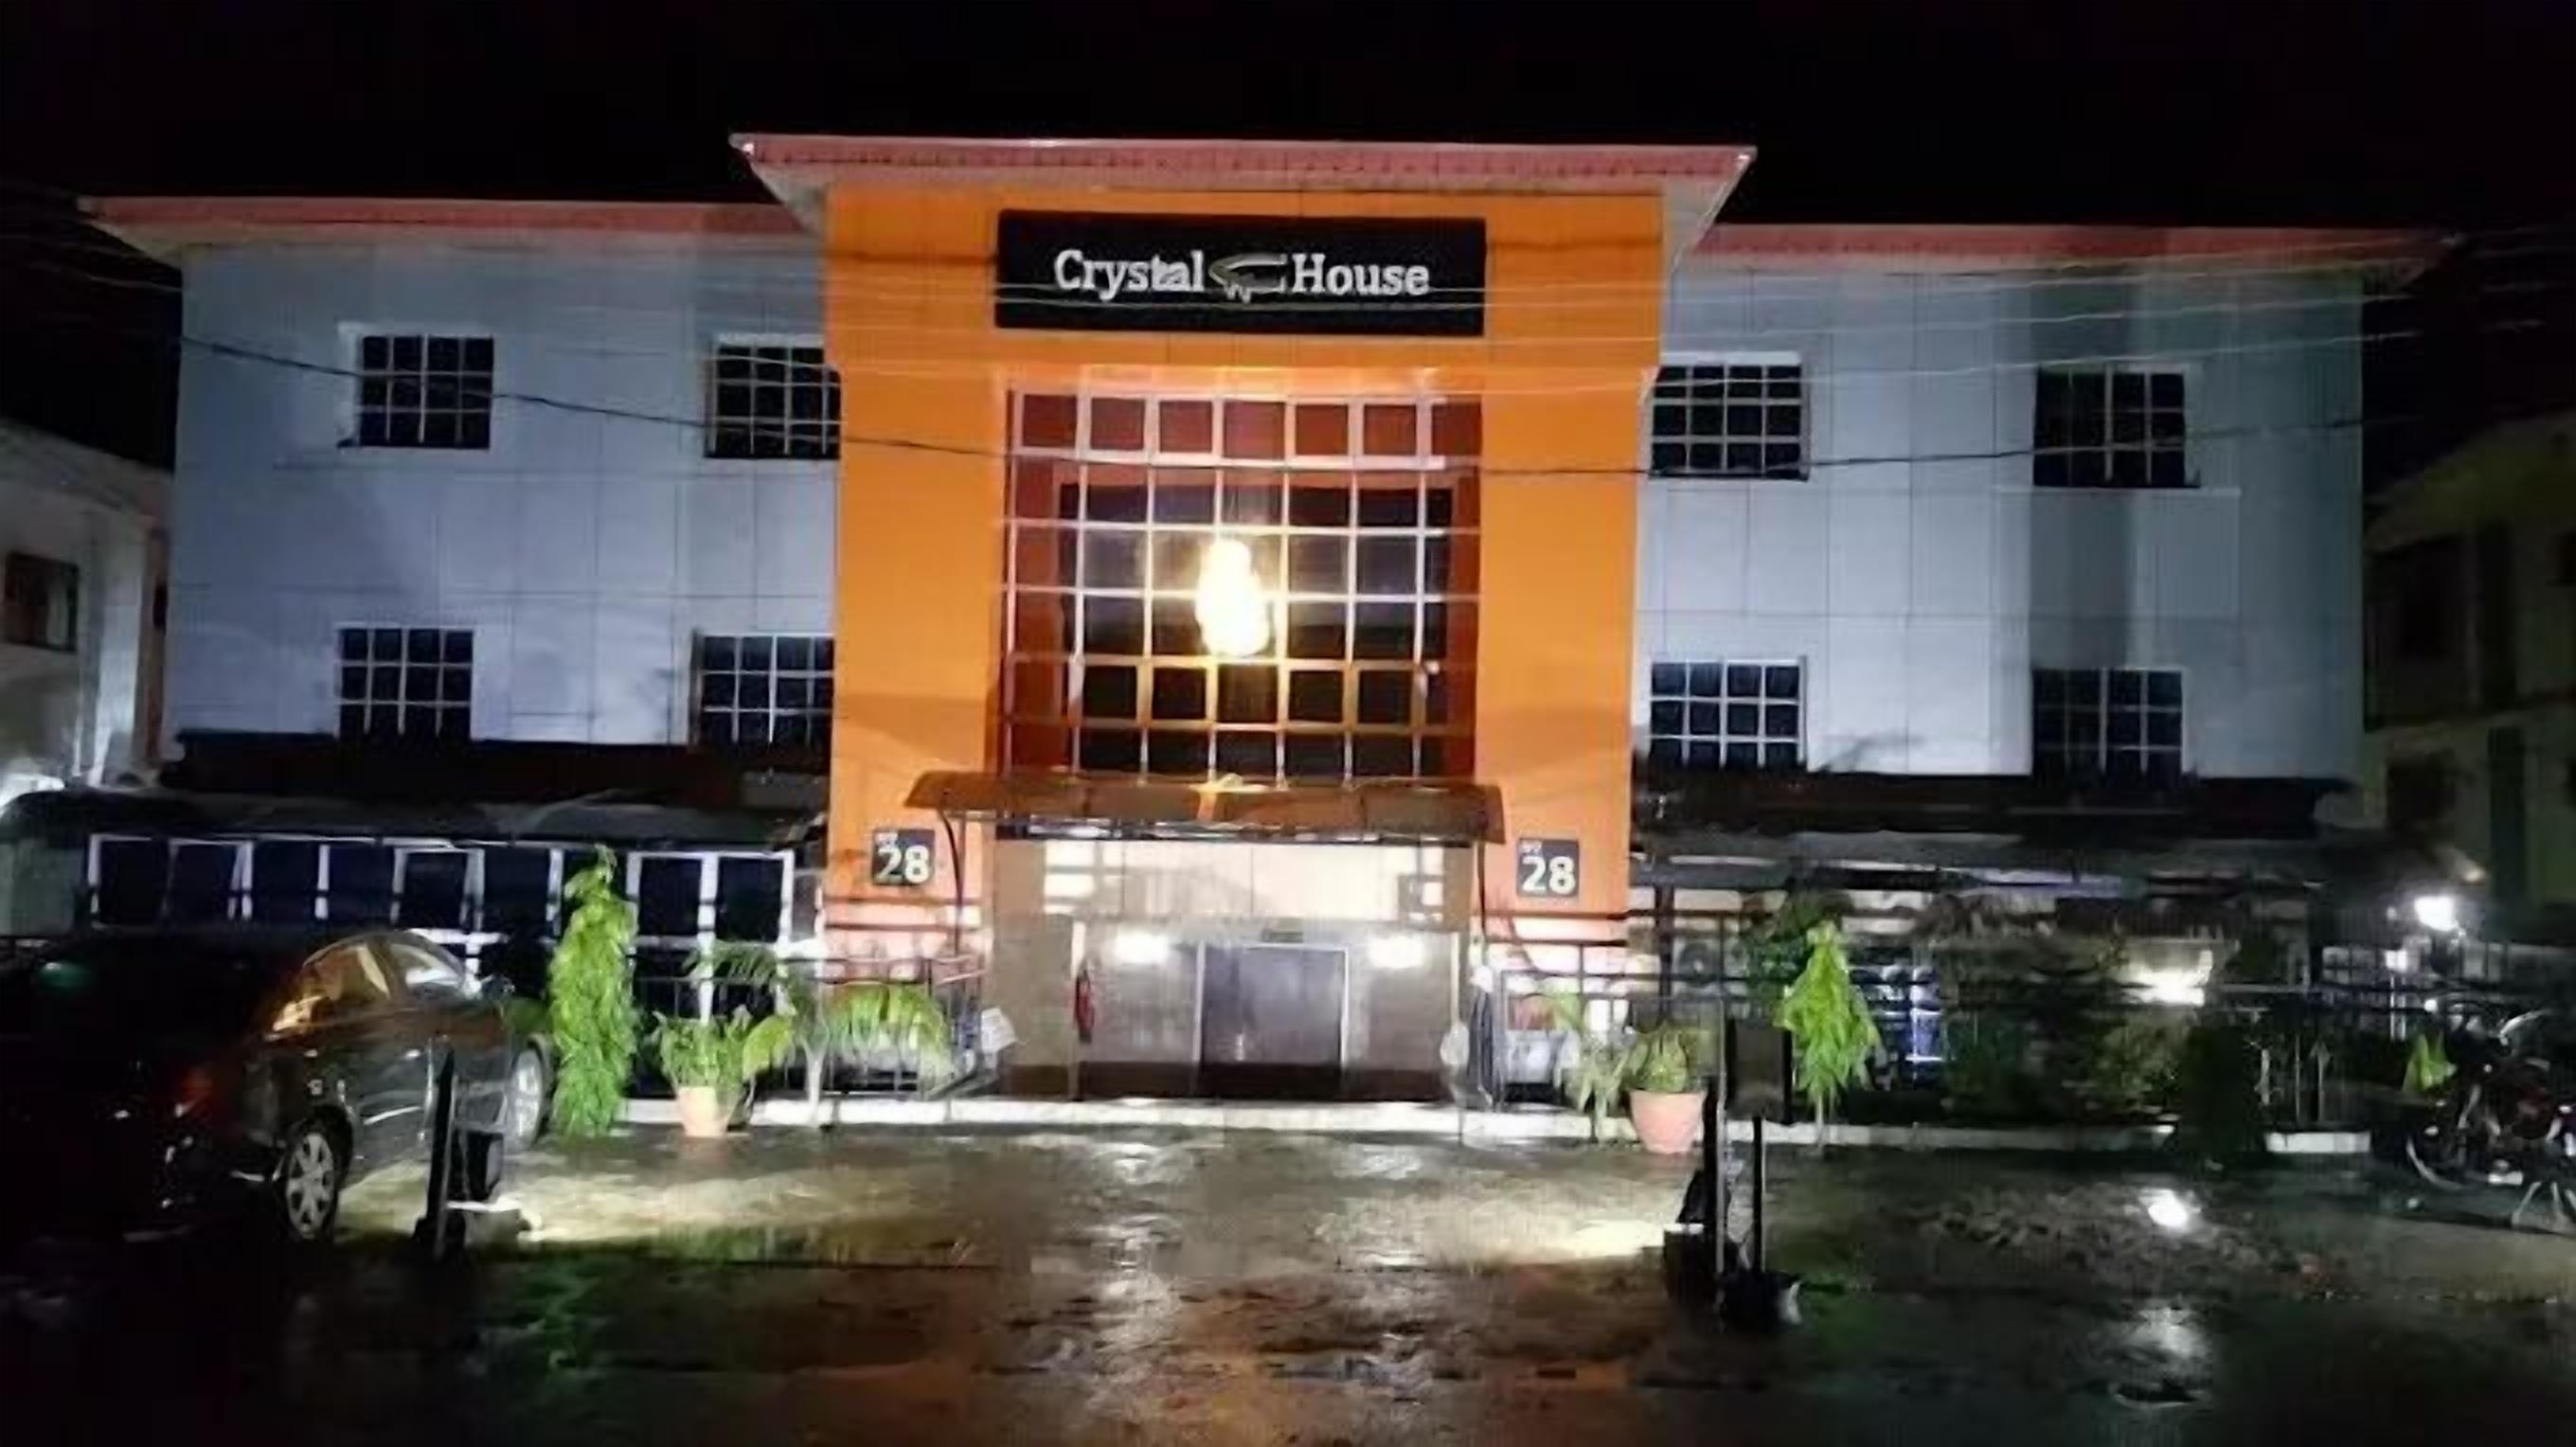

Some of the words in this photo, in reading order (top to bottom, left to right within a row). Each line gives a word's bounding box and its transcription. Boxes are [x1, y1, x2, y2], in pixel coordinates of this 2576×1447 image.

[1053, 249, 1206, 300] Crystal
[1291, 253, 1430, 295] House
[876, 845, 929, 884] 28
[1522, 856, 1576, 894] 28
